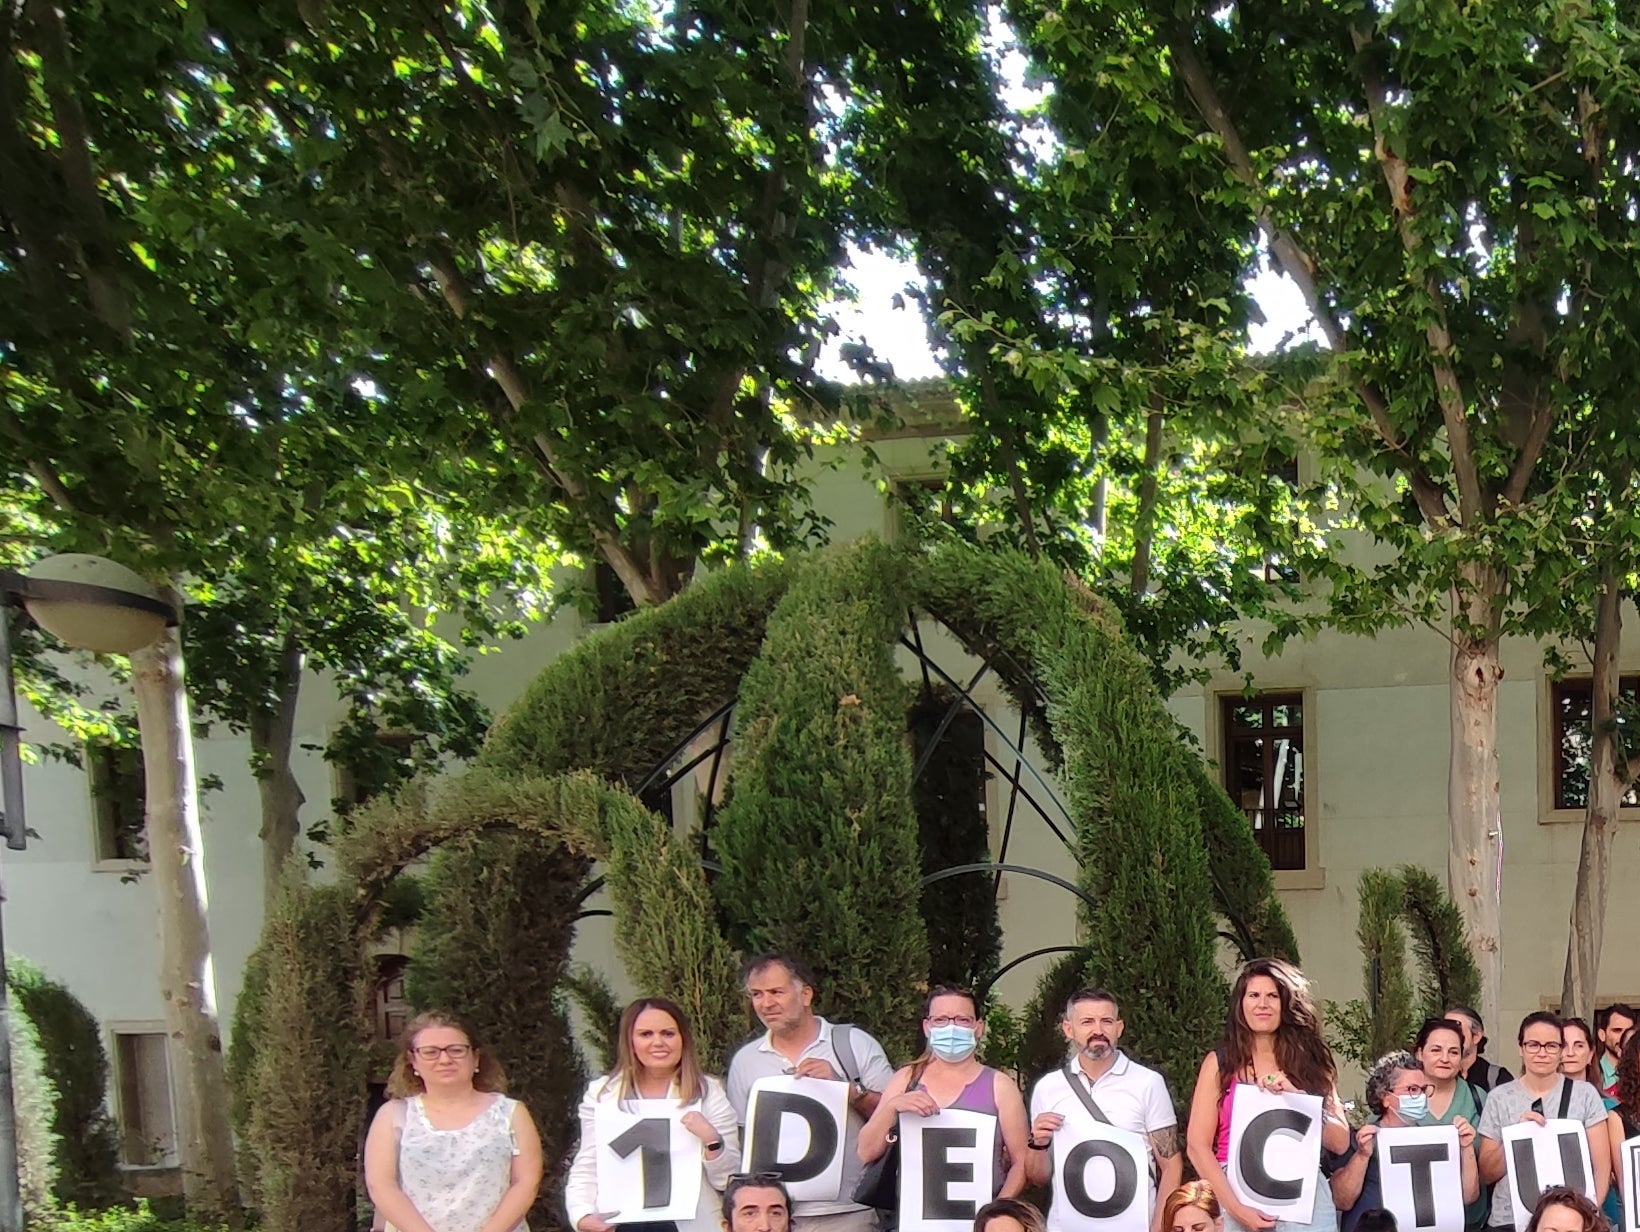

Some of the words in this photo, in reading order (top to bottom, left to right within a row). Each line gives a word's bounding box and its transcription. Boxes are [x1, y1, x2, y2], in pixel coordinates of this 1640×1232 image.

[609, 1117, 670, 1209] 1
[750, 1090, 838, 1182] D
[922, 1127, 977, 1220] E
[1062, 1139, 1138, 1220] O
[1239, 1109, 1312, 1200] C
[1512, 1132, 1588, 1216] U
[1390, 1143, 1449, 1228] T
